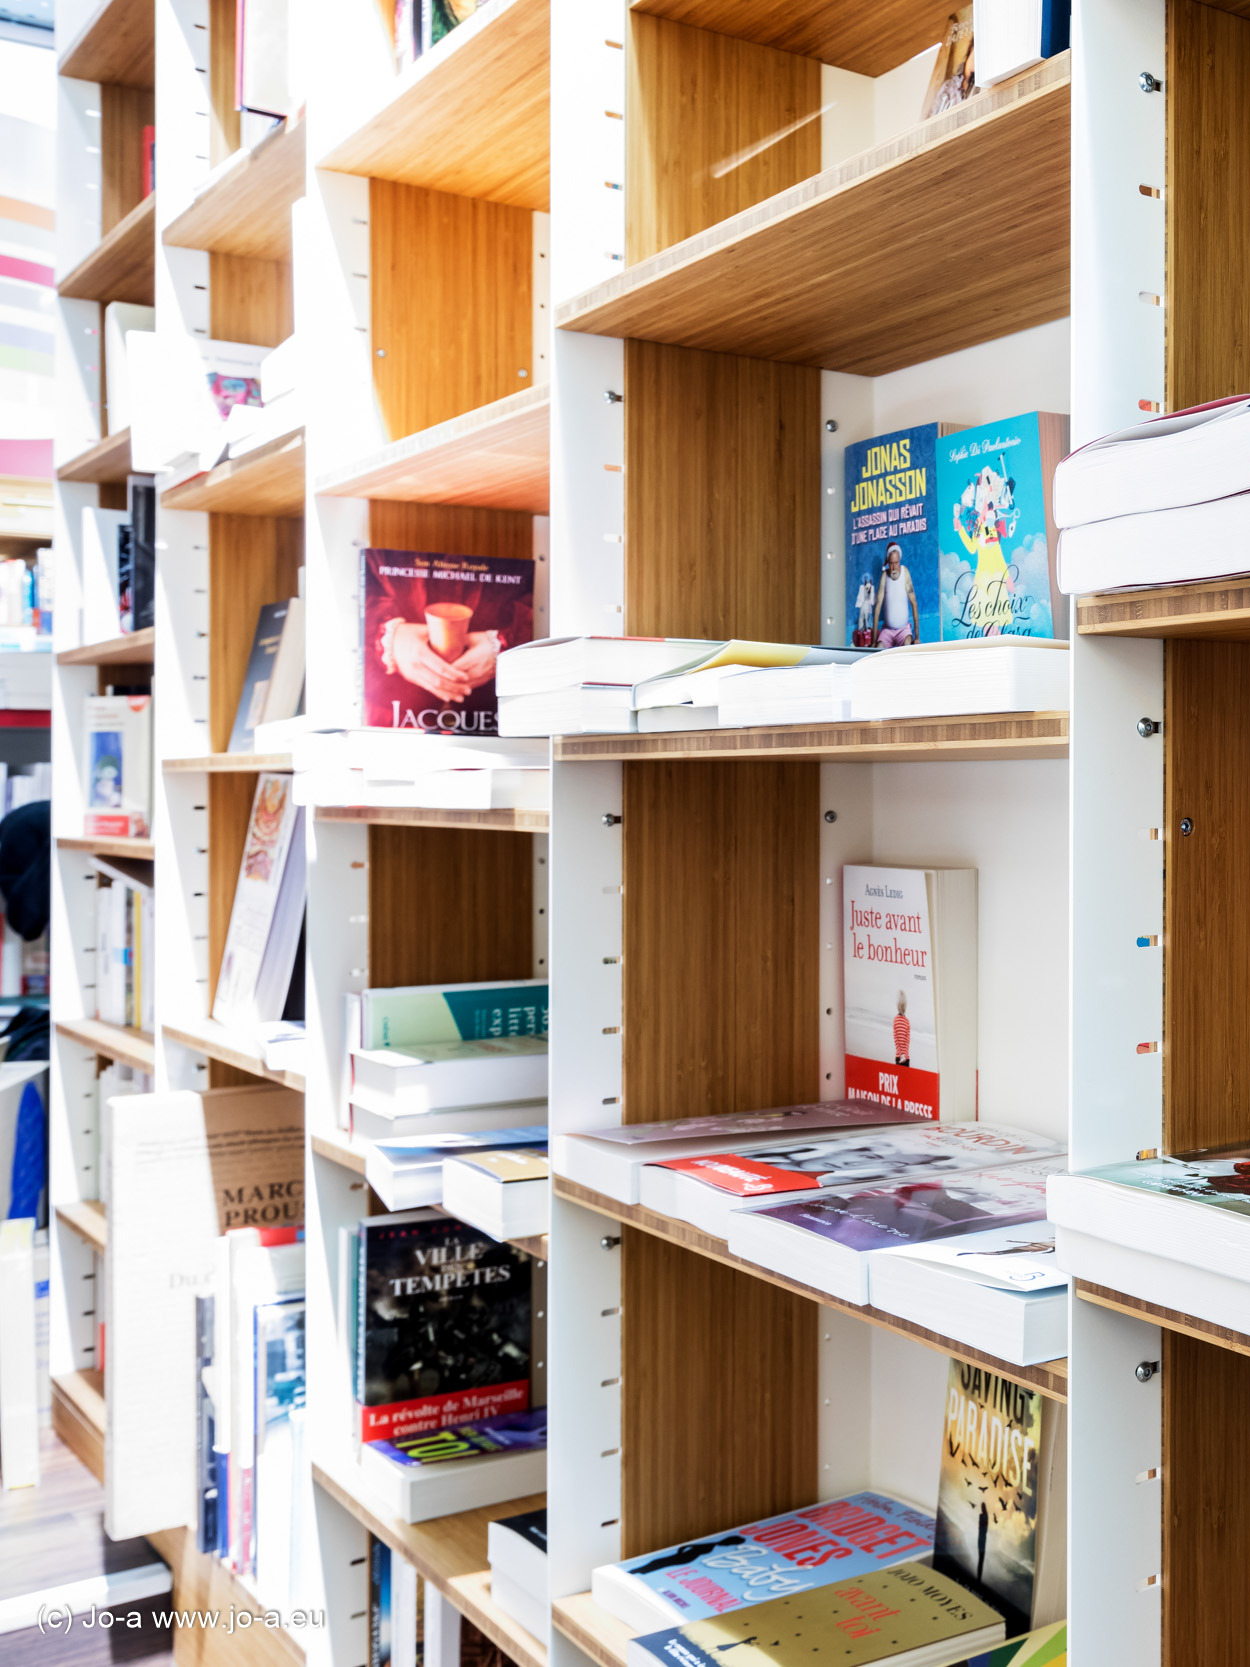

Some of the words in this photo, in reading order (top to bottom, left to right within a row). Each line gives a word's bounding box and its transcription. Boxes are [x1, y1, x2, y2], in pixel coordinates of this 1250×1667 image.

[862, 438, 911, 479] JONAS
[851, 467, 926, 513] JONASSON
[853, 511, 887, 530] L'ASSASSIN
[888, 508, 900, 522] QUI
[901, 503, 923, 520] RÊVAIT
[868, 526, 888, 541] PLACE
[889, 523, 898, 537] AU
[899, 518, 927, 535] PARADIS
[379, 565, 429, 579] PRINCESSE
[432, 570, 477, 582] MICHAEL
[479, 573, 492, 583] DE
[495, 574, 523, 584] KENT
[951, 570, 982, 627] Les
[985, 564, 1036, 620] choix
[850, 900, 882, 931] Juste
[885, 912, 922, 934] avant
[853, 932, 864, 959] le
[867, 934, 927, 967] bonheur
[879, 1072, 899, 1095] PRIX
[922, 1125, 1038, 1155] BOURDIN
[225, 1202, 305, 1228] PROU
[415, 1242, 487, 1266] VILLE
[368, 1413, 389, 1427] La
[392, 1404, 440, 1423] révolte
[442, 1400, 460, 1412] de
[462, 1388, 524, 1409] Marseille
[960, 1363, 1026, 1426] SAVING
[393, 1418, 439, 1436] contre
[441, 1408, 480, 1426] Henri
[947, 1387, 1035, 1496] PARADISE
[739, 1519, 854, 1569] JONES
[797, 1501, 932, 1560] BRIDGET
[665, 1566, 698, 1580] LE
[702, 1544, 815, 1602] Baby
[678, 1576, 743, 1613] JOURNAL
[834, 1587, 901, 1621] avant
[887, 1568, 924, 1587] JOJO
[921, 1585, 973, 1621] MOYES
[835, 1615, 881, 1639] toi
